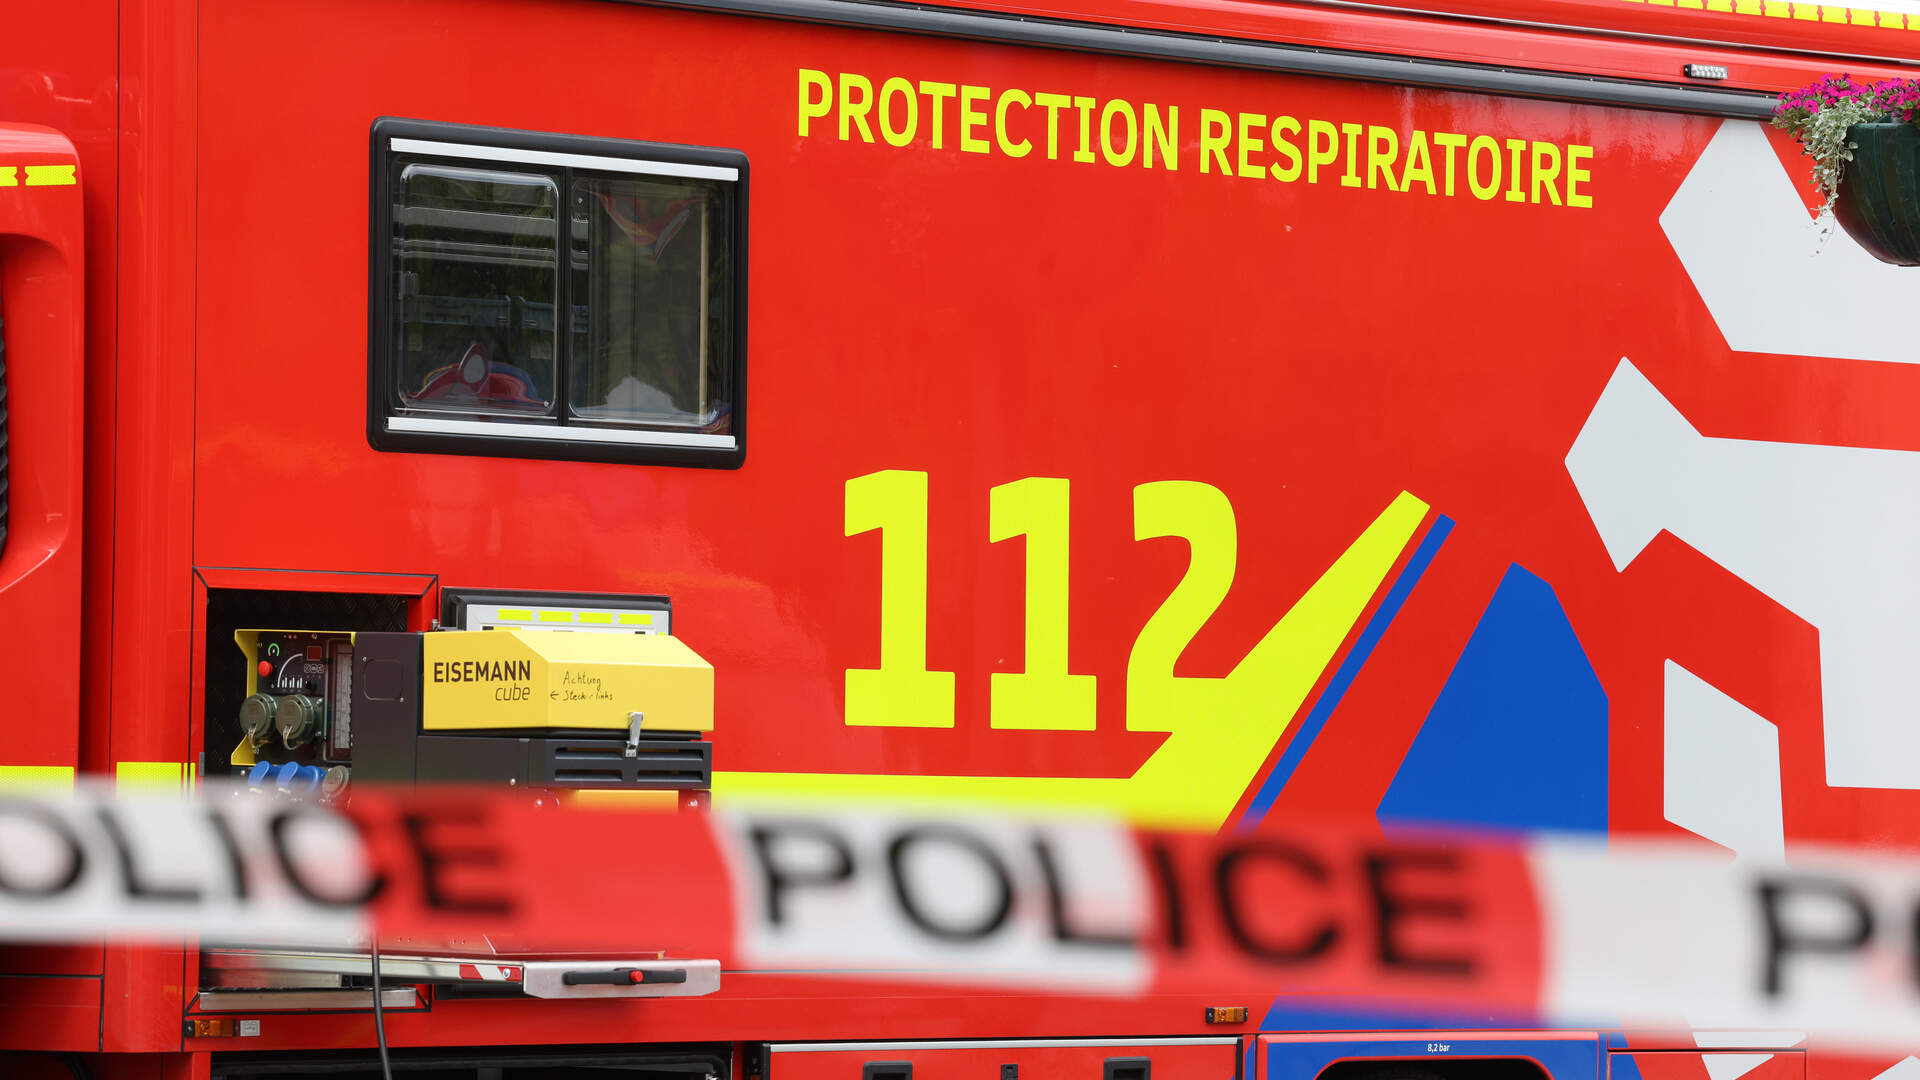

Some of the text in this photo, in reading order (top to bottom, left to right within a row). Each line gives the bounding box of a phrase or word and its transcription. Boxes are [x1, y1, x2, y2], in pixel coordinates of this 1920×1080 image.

[798, 68, 1594, 209] PROTECTION RESPIRATOIRE
[845, 469, 1237, 732] 112
[434, 660, 531, 683] EISEMANN
[563, 670, 601, 692] Achtung
[495, 683, 531, 701] cube
[745, 817, 1477, 979] POLICE
[1427, 1043, 1450, 1053] 8,2 bar
